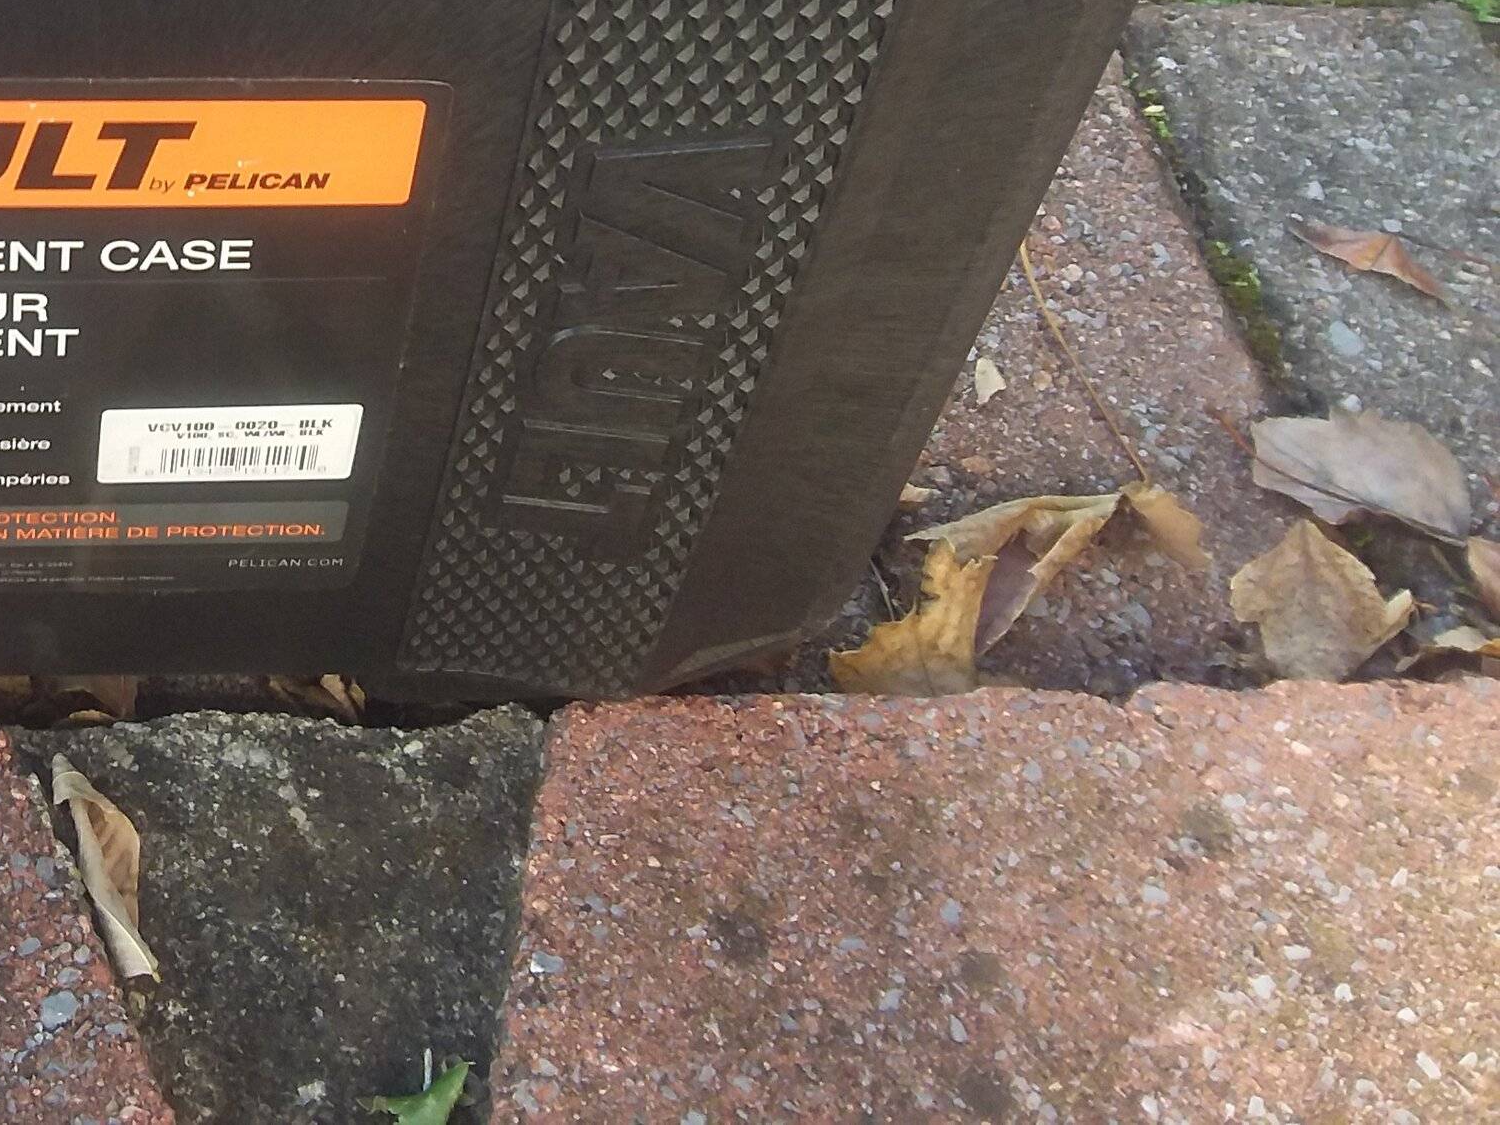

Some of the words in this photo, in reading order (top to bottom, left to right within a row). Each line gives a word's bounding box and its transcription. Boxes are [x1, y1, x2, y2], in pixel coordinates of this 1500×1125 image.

[149, 176, 176, 193] by
[183, 172, 331, 191] PELICAN
[100, 239, 254, 272] CASE
[126, 526, 158, 539] DE
